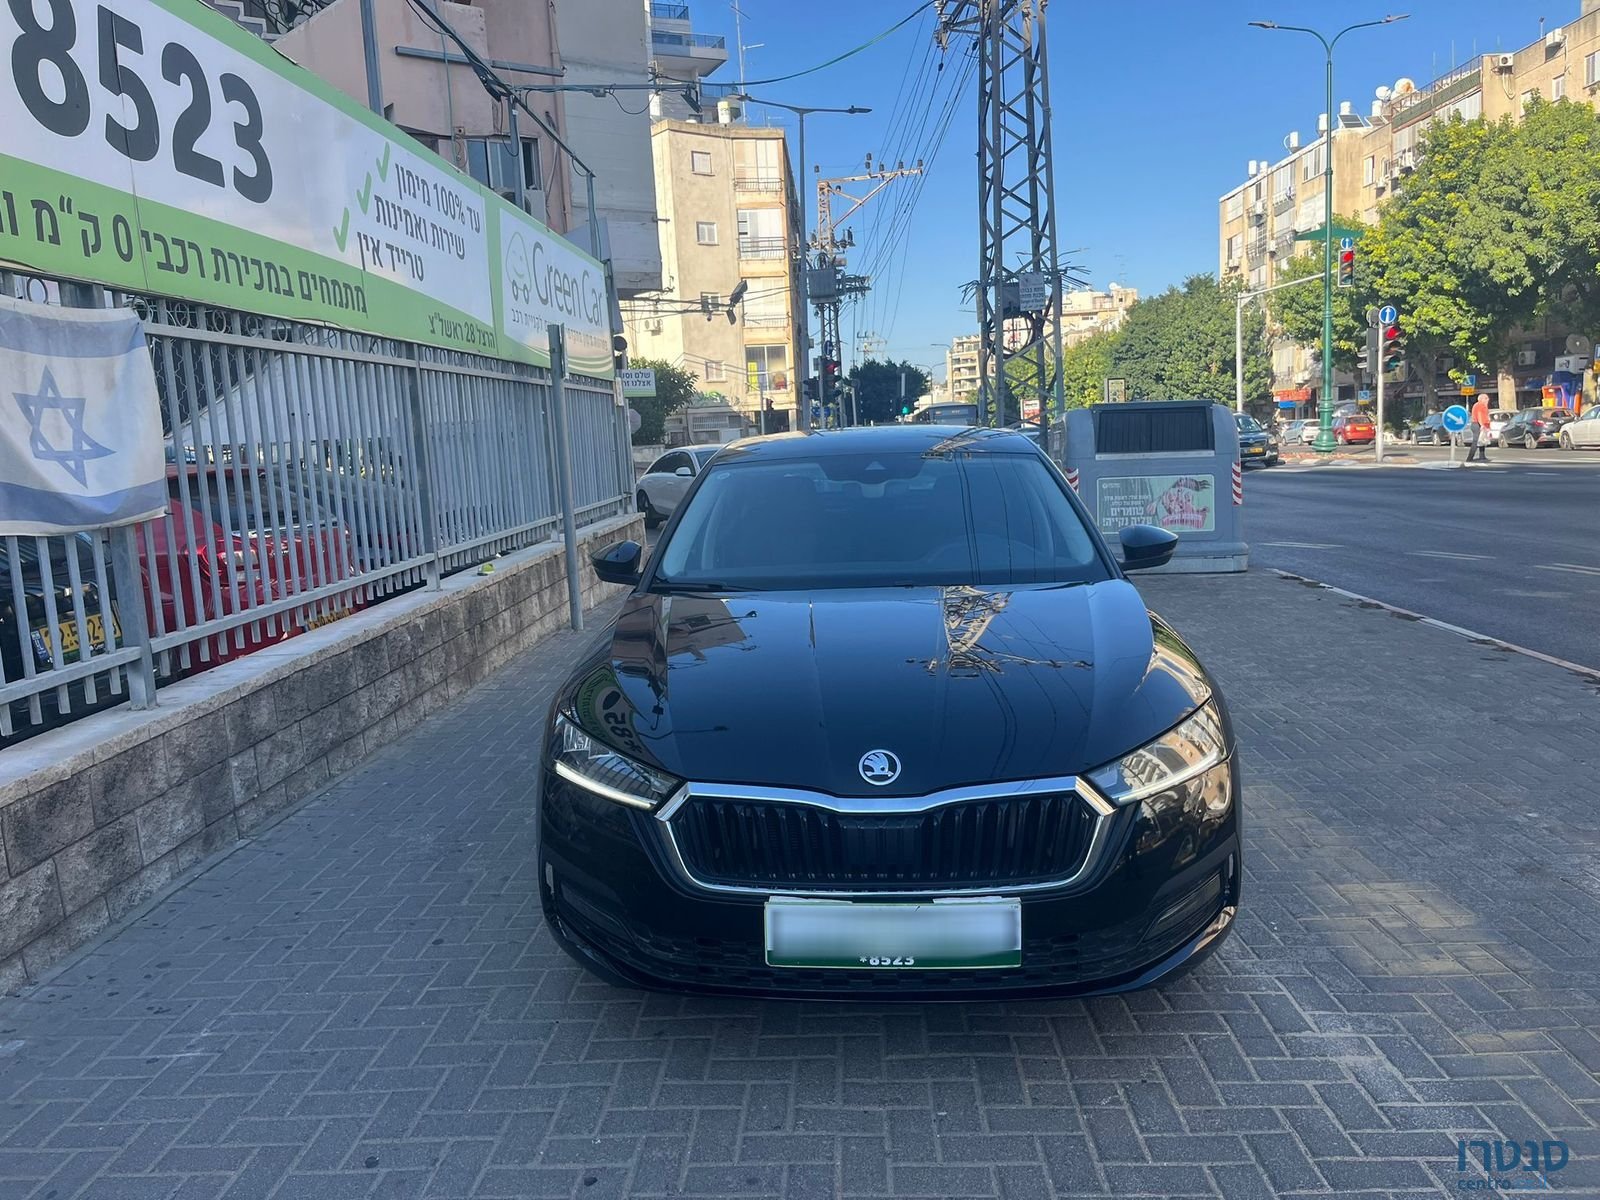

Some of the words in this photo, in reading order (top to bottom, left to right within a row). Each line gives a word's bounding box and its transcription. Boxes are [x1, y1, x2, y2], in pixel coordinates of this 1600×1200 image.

[11, 0, 273, 204] 8523
[395, 163, 431, 207] מימון
[433, 183, 466, 225] 100%
[0, 190, 19, 237] ו
[374, 194, 429, 244] ואמינות
[467, 206, 481, 234] עד
[112, 214, 134, 262] 0
[140, 228, 206, 278] רכבי
[356, 231, 384, 271] אין
[430, 222, 465, 260] שירות
[210, 246, 295, 297] במכירת
[385, 242, 425, 281] טרייד
[297, 270, 368, 313] מתמחים
[533, 242, 581, 319] Green
[581, 269, 603, 328] Car
[464, 320, 476, 344] 28
[475, 322, 496, 349] הרצל
[631, 379, 651, 387] אצלנו
[634, 371, 651, 379] שלם
